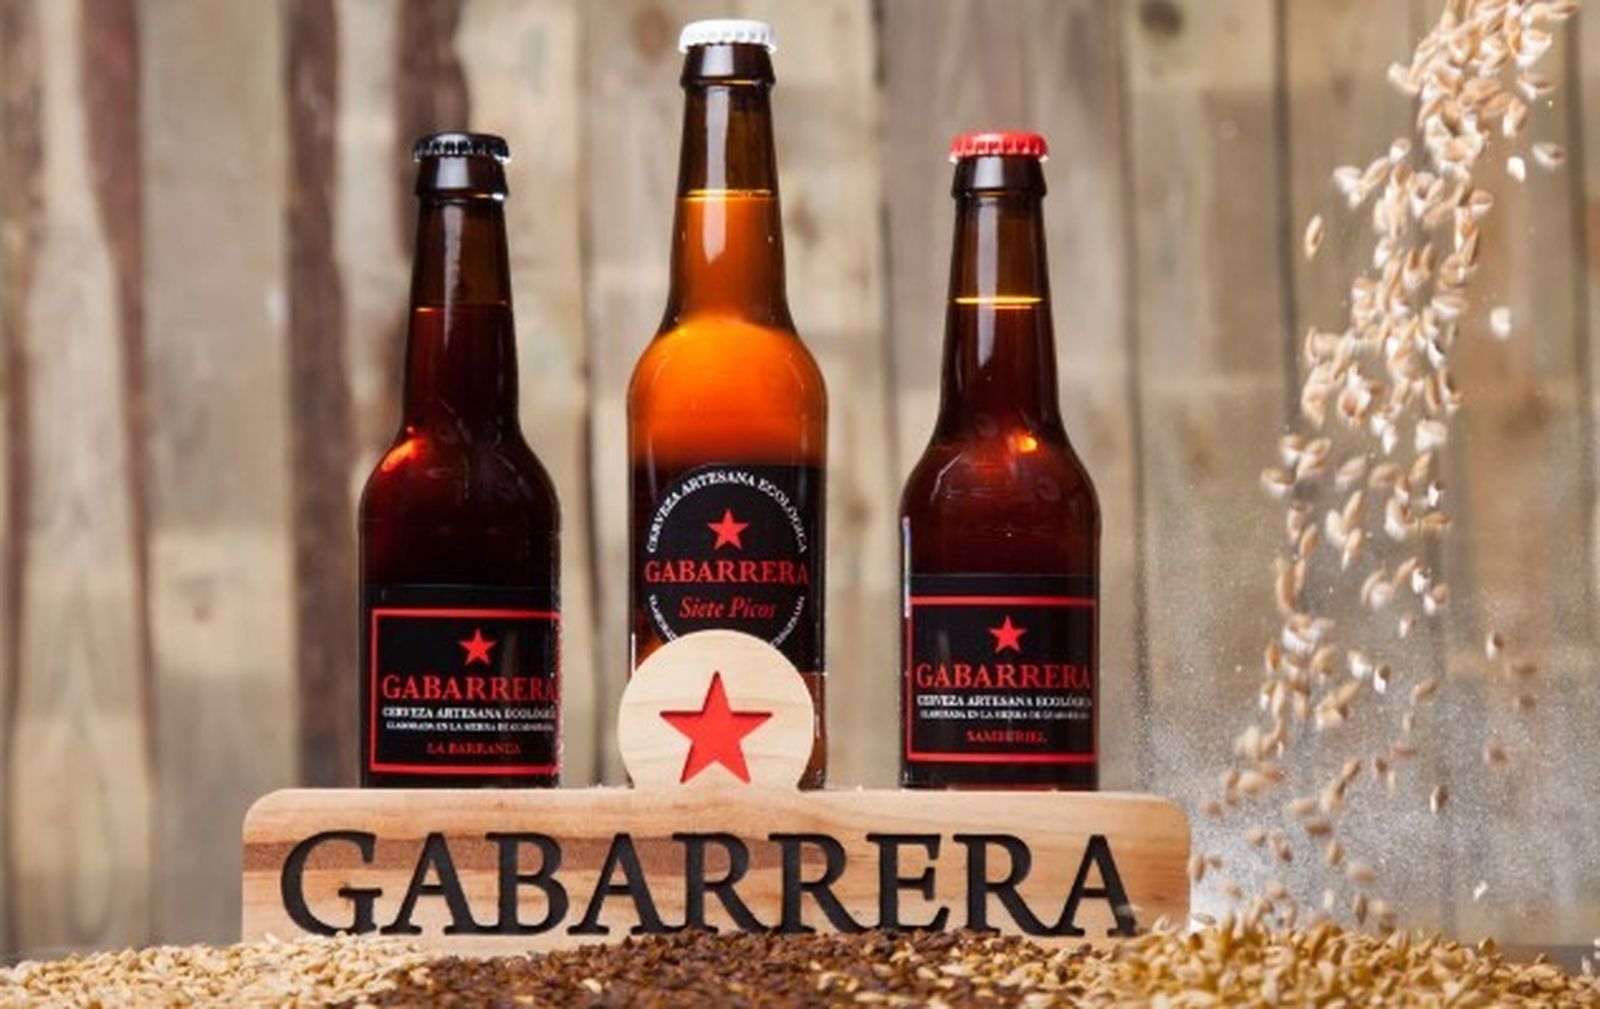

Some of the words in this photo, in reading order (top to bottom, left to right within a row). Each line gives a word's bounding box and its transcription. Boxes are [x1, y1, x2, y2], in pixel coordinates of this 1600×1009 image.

[681, 470, 755, 496] ARTESANA
[644, 559, 810, 583] GABARRERA
[679, 595, 725, 618] Siete
[914, 662, 1092, 689] GABARRERA
[382, 706, 434, 719] CERVEZA
[436, 707, 502, 719] ARTESANA
[916, 694, 965, 707] CERVEZA
[967, 694, 1033, 707] ARTESANA
[280, 829, 1139, 937] GABARRERA
